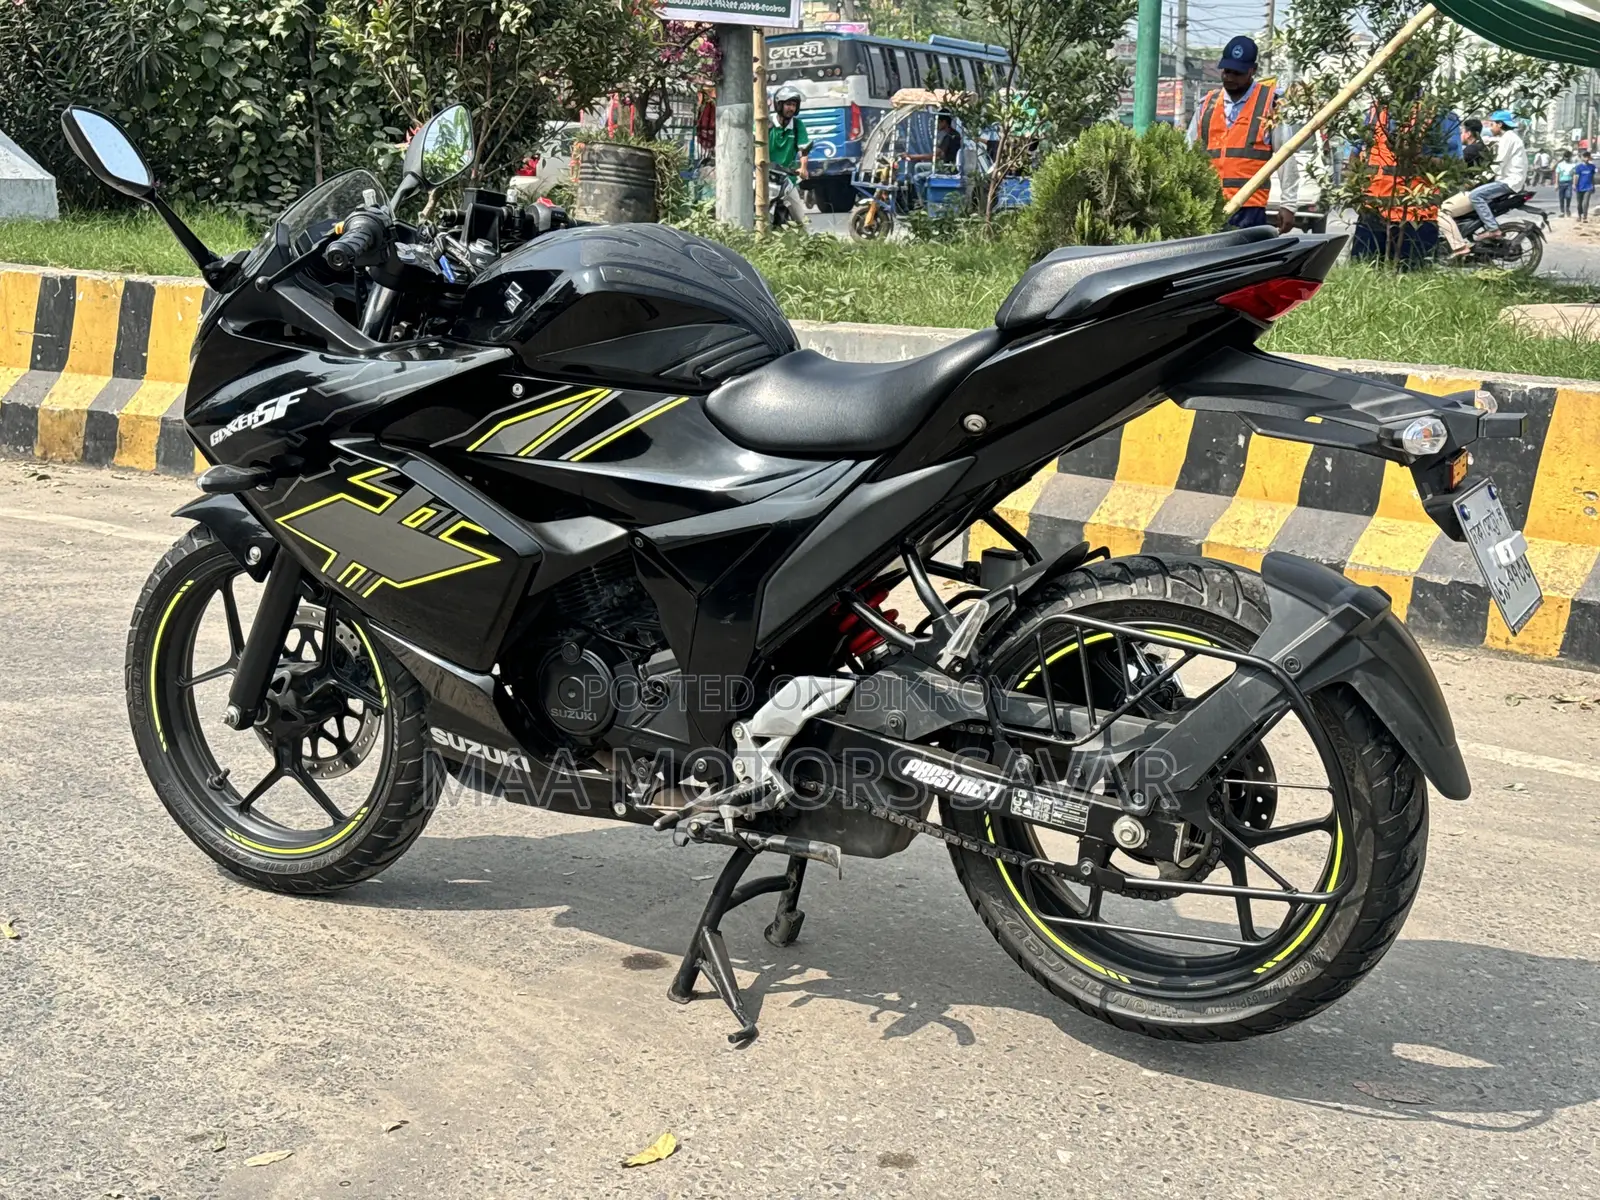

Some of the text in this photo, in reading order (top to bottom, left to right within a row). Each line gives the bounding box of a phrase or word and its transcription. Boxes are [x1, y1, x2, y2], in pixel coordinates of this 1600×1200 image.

[550, 707, 598, 722] SUZUKI
[429, 726, 532, 773] SUZUKI
[901, 758, 1008, 802] PROSTREET
